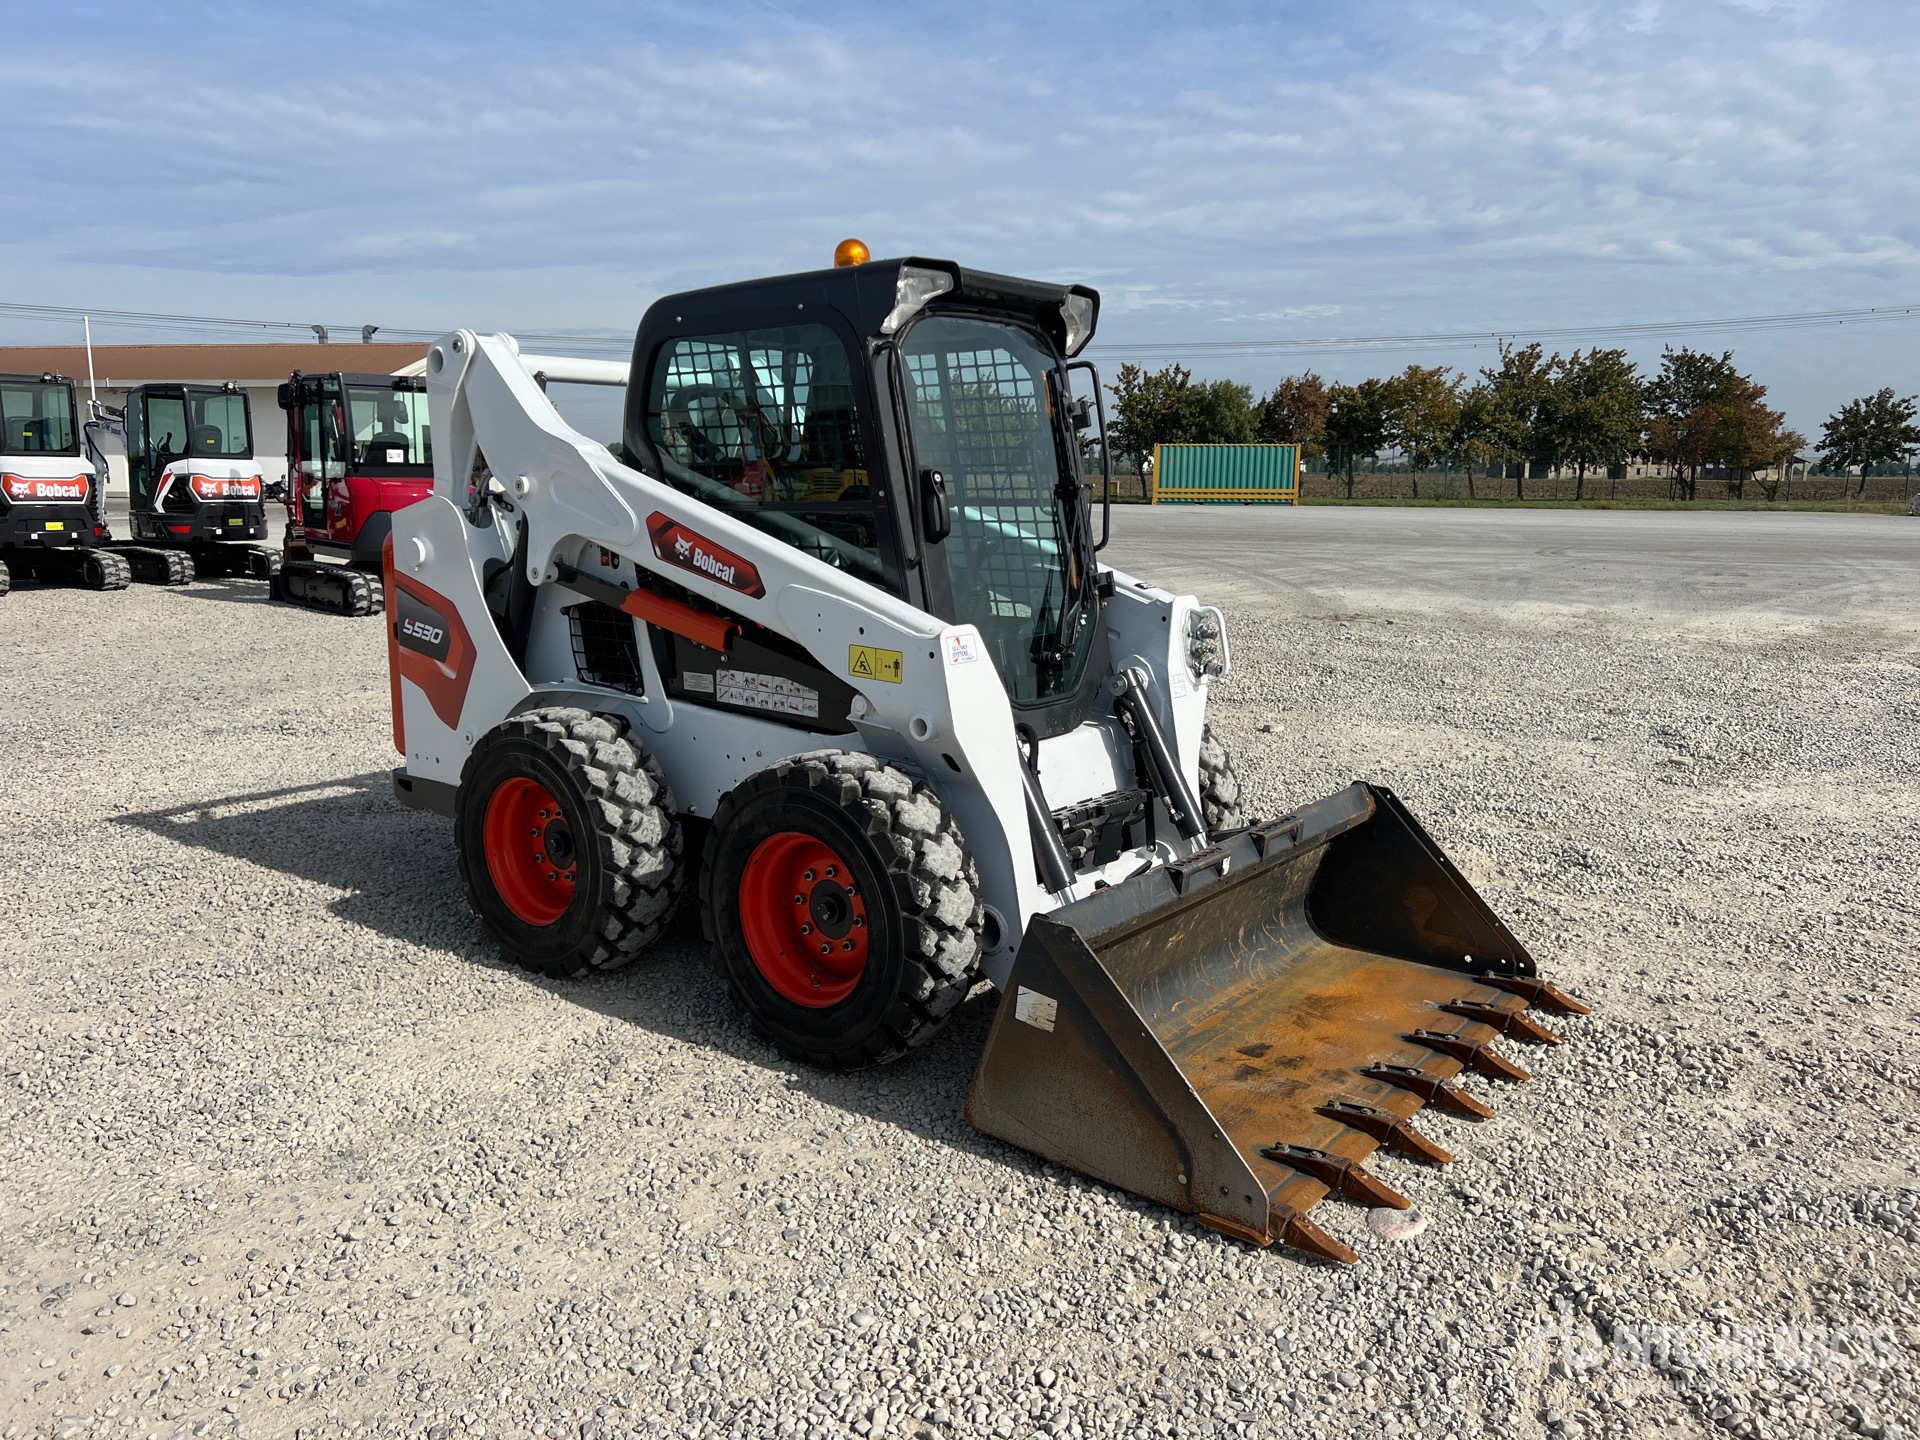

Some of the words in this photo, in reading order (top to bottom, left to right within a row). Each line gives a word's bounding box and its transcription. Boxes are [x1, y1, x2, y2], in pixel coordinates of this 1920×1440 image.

[36, 483, 81, 497] Bobcat
[222, 483, 257, 496] Bobcat
[693, 547, 735, 585] Bobcat
[402, 618, 443, 644] S530
